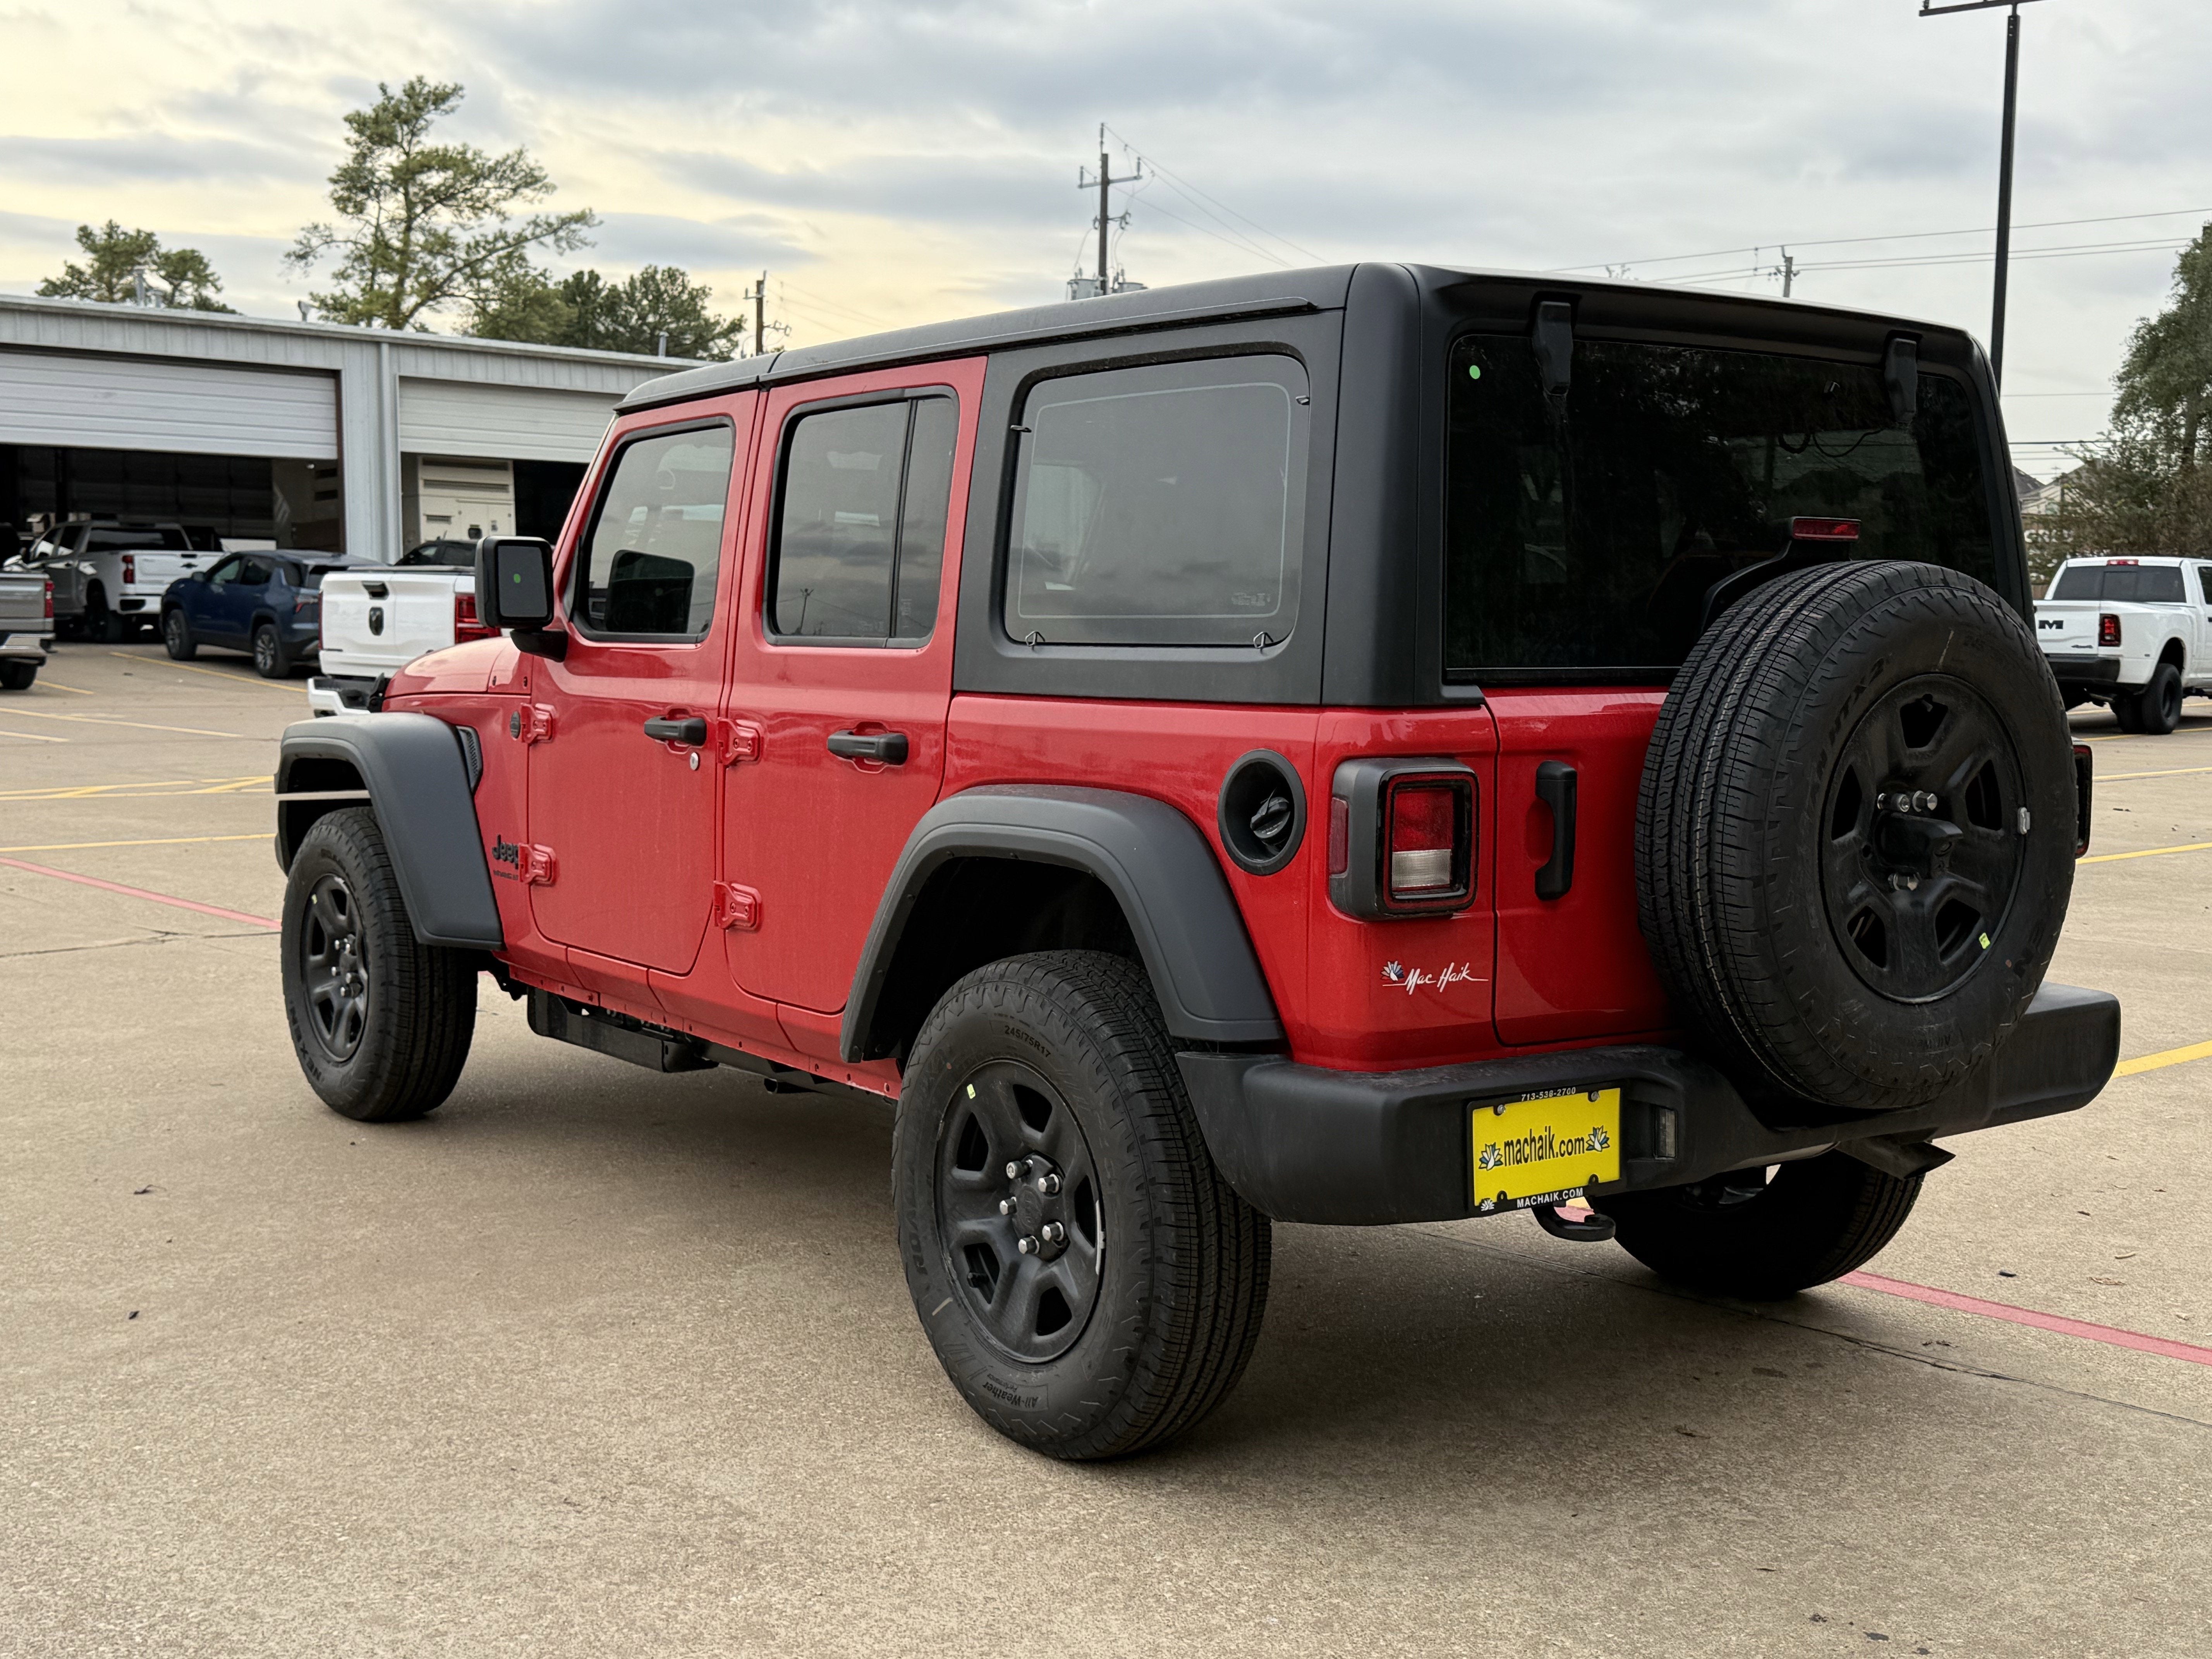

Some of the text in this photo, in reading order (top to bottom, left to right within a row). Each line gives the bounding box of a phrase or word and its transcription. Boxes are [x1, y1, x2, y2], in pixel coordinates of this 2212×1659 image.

[1382, 962, 1489, 995] Mac Haik
[1005, 1025, 1051, 1058] 245/75R17
[1504, 1125, 1585, 1166] machaik.com
[1517, 1187, 1583, 1208] MACHAIK.COM
[982, 1381, 1039, 1408] All-Weather
